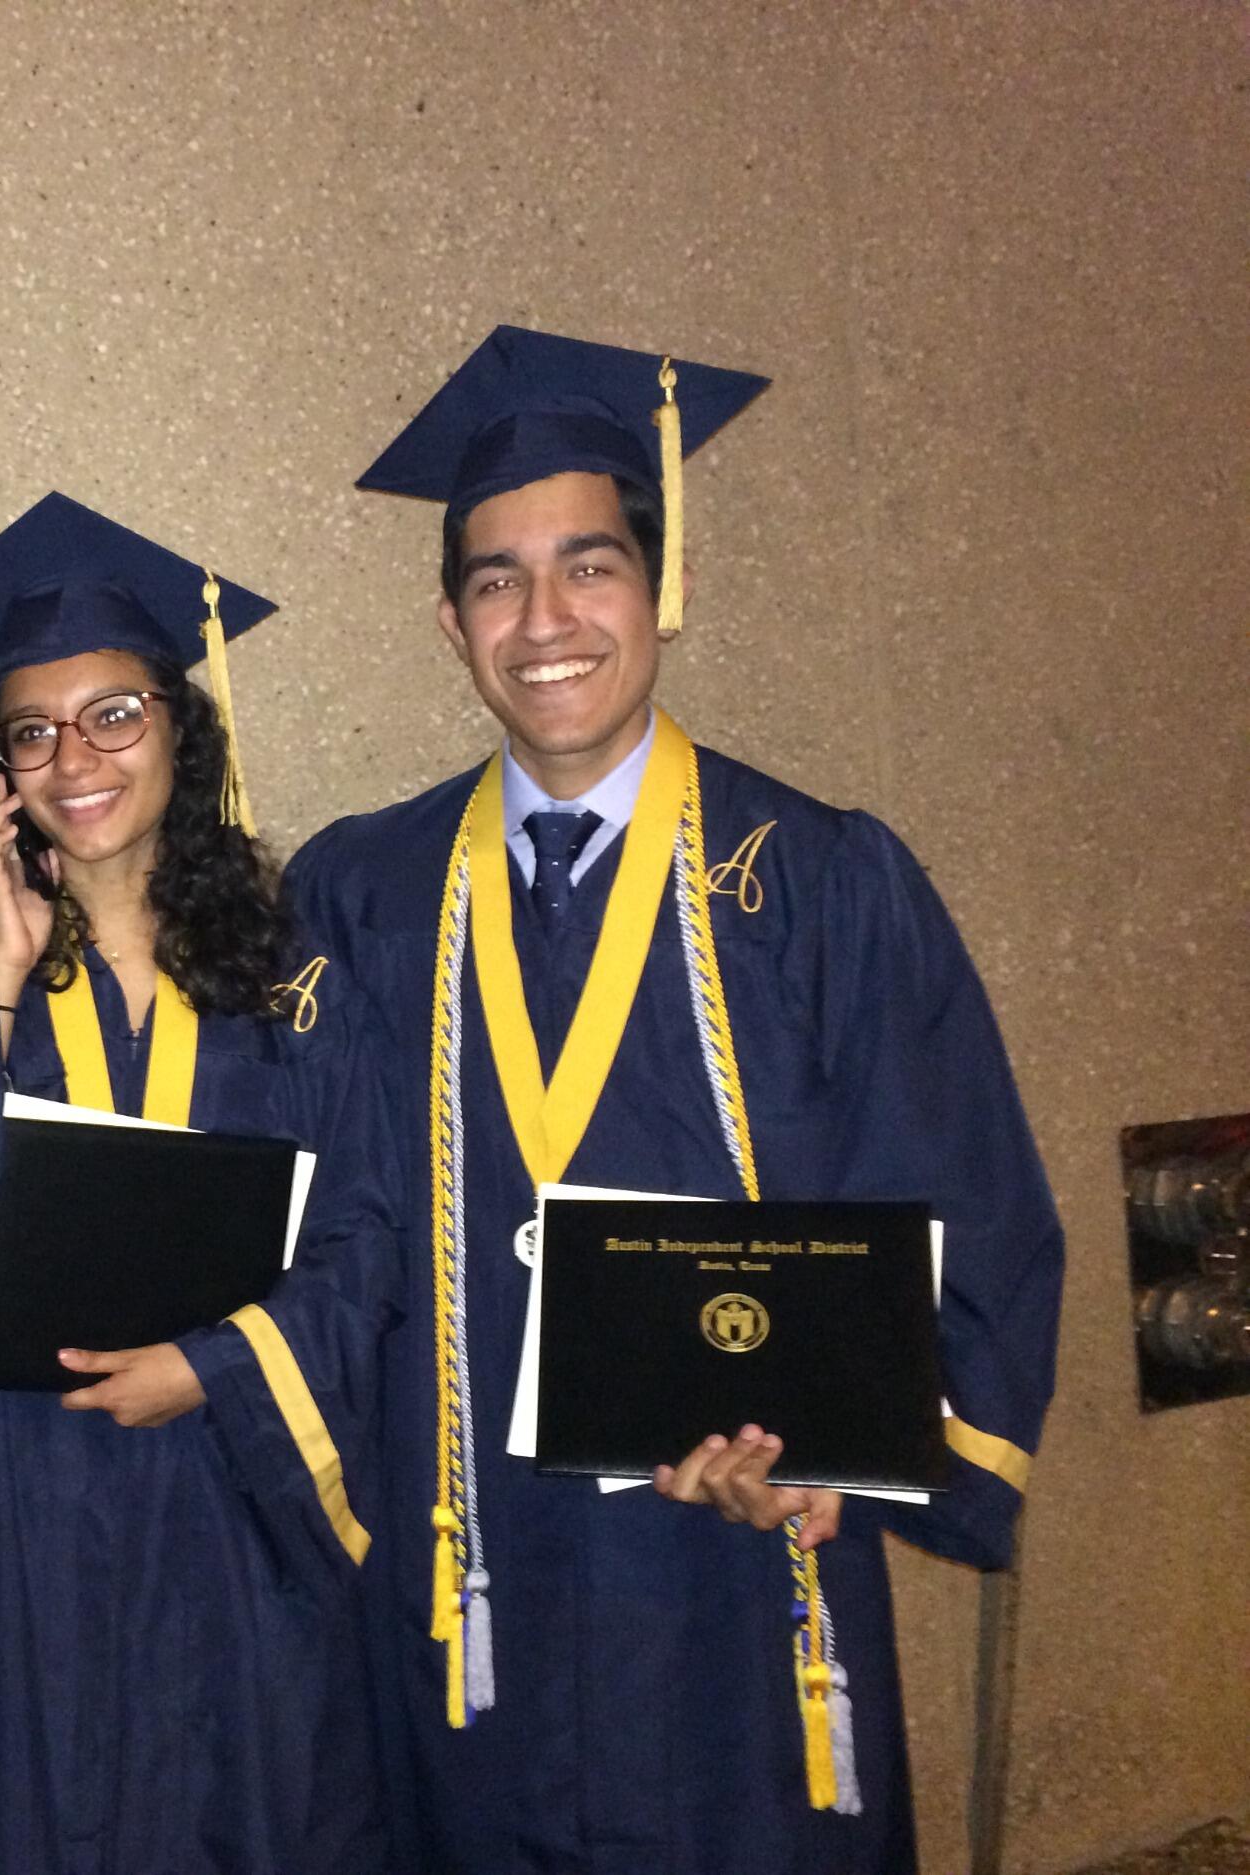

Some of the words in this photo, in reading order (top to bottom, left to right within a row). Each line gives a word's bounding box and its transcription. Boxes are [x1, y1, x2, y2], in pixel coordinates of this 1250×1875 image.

[605, 1238, 652, 1251] Austin
[657, 1239, 742, 1253] Independent
[750, 1240, 802, 1254] School
[809, 1241, 869, 1254] District
